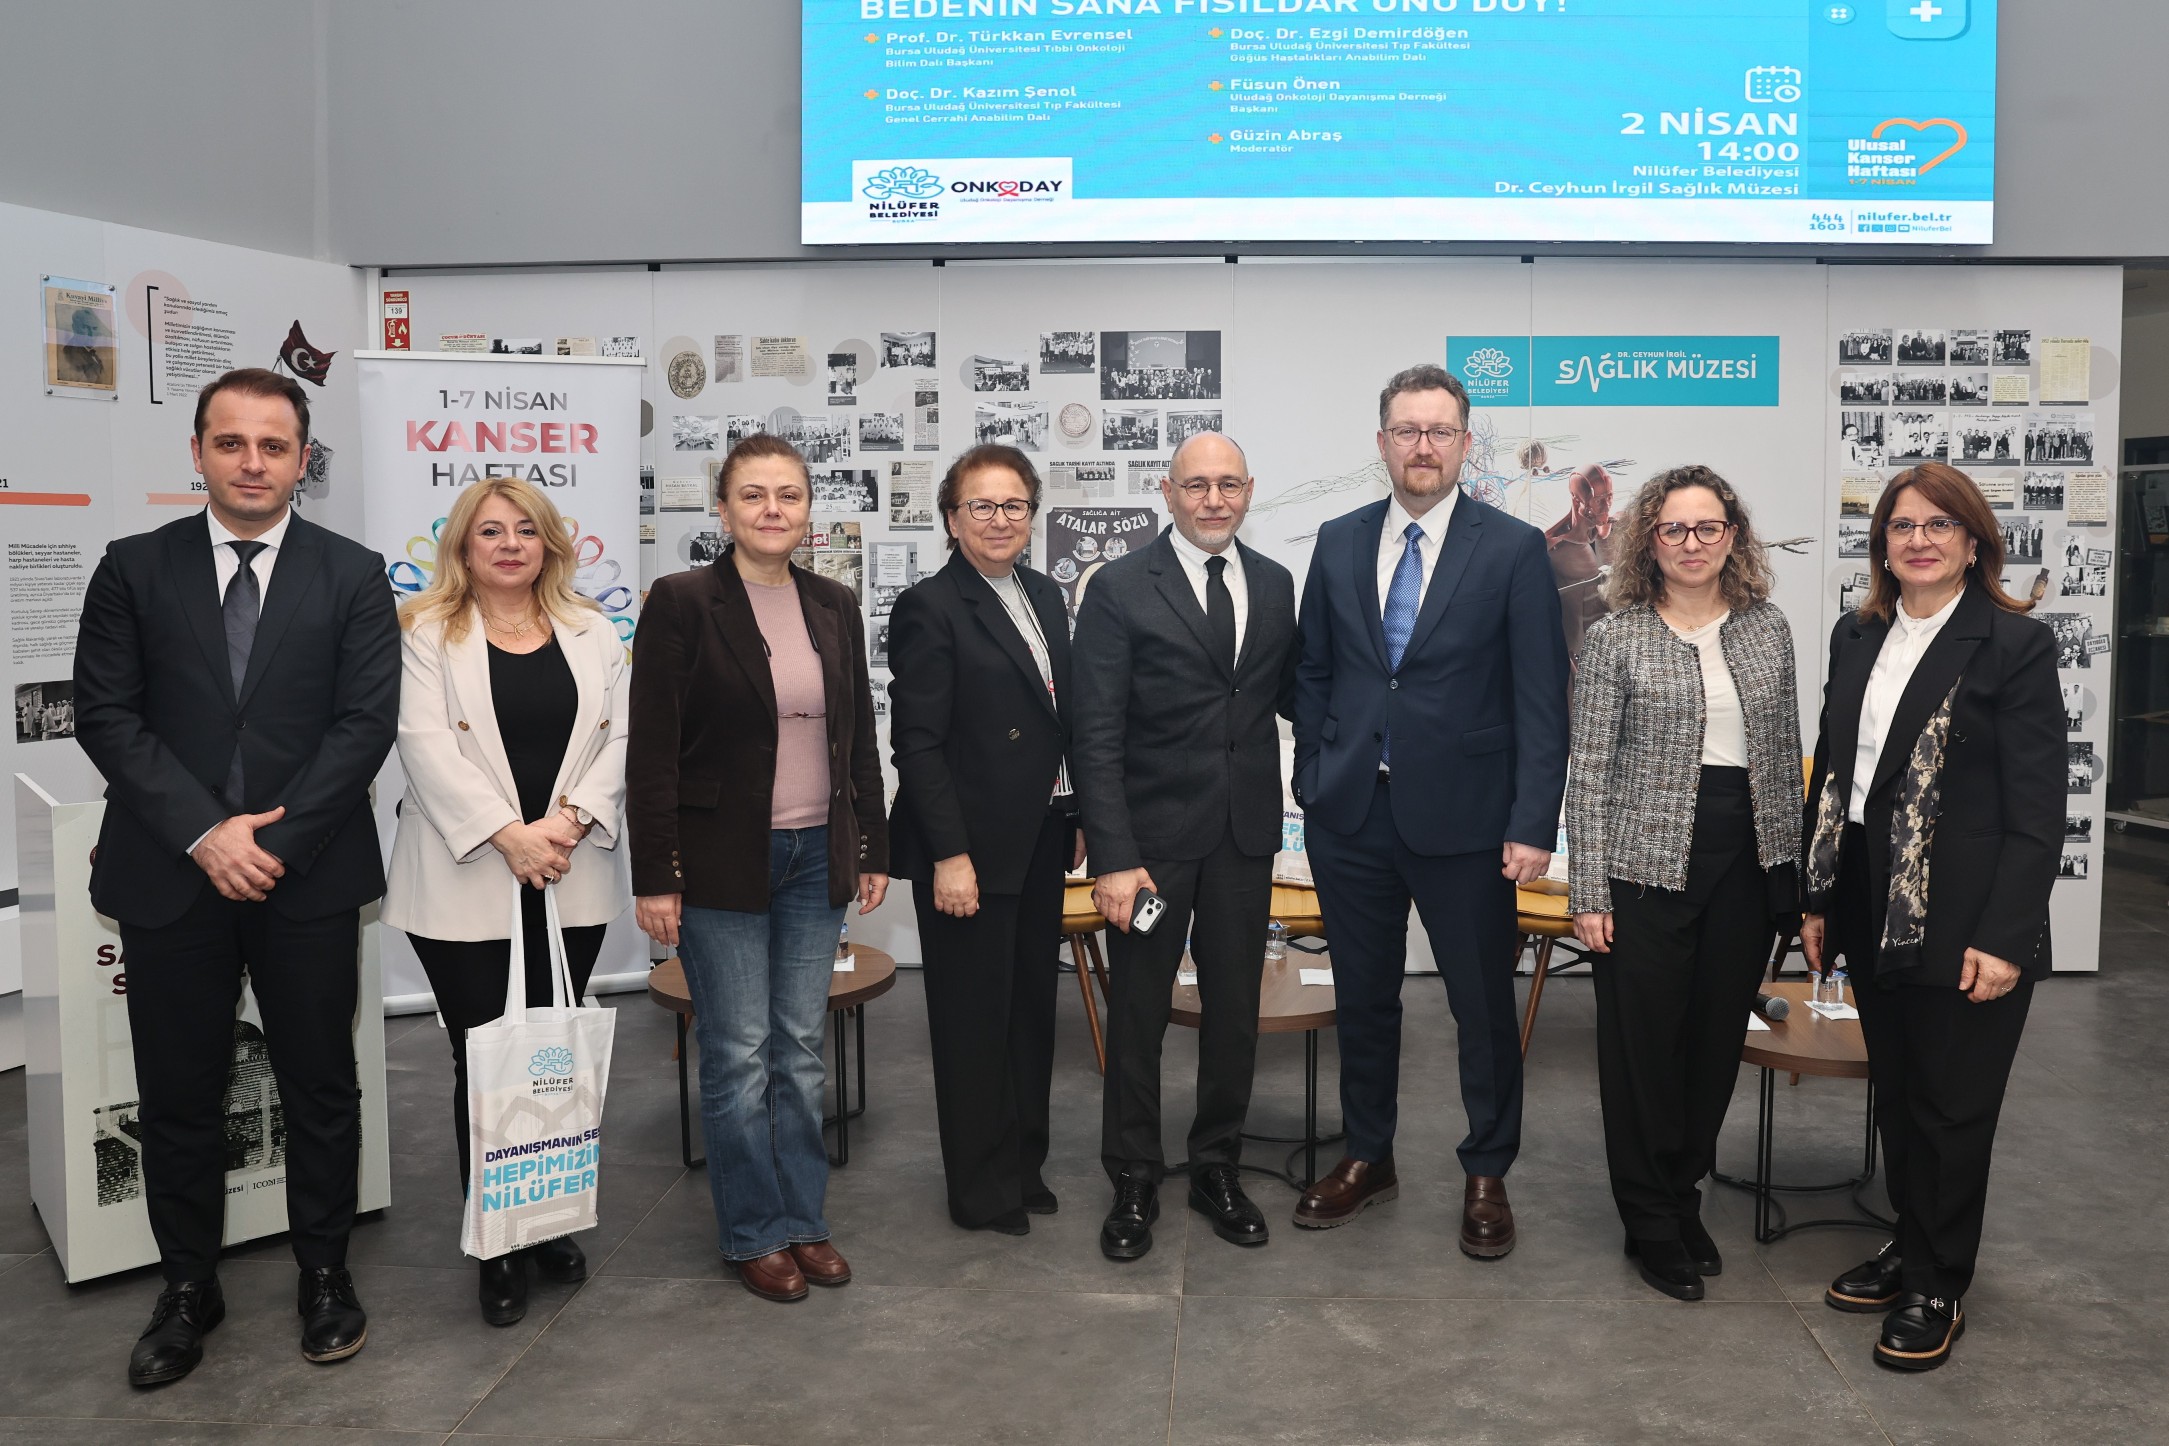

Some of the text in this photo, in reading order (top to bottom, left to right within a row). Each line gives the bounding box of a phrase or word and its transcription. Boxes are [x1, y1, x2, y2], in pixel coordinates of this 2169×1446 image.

[1051, 0, 1161, 15] SANA
[1174, 0, 1359, 14] FISILDAR
[1372, 0, 1455, 12] ONU
[887, 29, 1132, 44] Prof. Dr. Türkkan Evrensel
[1231, 27, 1468, 42] Doç. Dr. Ezgi Demirdöğen
[924, 47, 965, 56] Uludağ
[970, 44, 1040, 54] Üniversitesi
[1044, 44, 1073, 52] Tıbbi
[1076, 44, 1125, 53] Onkoloji
[1231, 41, 1470, 51] Bursa Uludağ Üniversitesi Tıp Fakültesi
[886, 59, 993, 68] Bilim Dalı Başkanı
[1230, 54, 1267, 63] Göğüs
[1346, 53, 1399, 61] Anabilim
[1403, 53, 1426, 61] Dalı
[1231, 76, 1340, 90] Füsun Önen
[887, 86, 1077, 101] Doç. Dr. Kazım Şenol
[1230, 92, 1447, 102] Uludağ Onkoloji Dayanışma Derneği
[886, 101, 1121, 112] Bursa Uludağ Üniversitesi Tıp Fakültesi
[1230, 105, 1278, 114] Başkanı
[886, 113, 1050, 123] Genel Cerrahi Anabilim Dalı
[1620, 107, 1798, 135] 2 NİSAN
[1230, 130, 1342, 142] Güzin Abraş
[1230, 145, 1294, 153] Moderatör
[1698, 141, 1799, 161] 14:00
[1848, 139, 1906, 151] Ulusal
[1848, 152, 1916, 164] Kanser
[1633, 165, 1799, 179] Nilüfer Belediyesi
[1848, 165, 1916, 177] Haftası
[1495, 180, 1799, 197] Dr. Ceyhun İrgil Sağlık Müzesi
[870, 201, 940, 210] NİLÜFER
[870, 210, 938, 218] BELEDİYESİ
[1858, 212, 1952, 221] nilufer.bel.tr
[1666, 350, 1687, 358] İRGİL
[1555, 353, 1756, 393] SAĞLIK MÜZESİ
[439, 386, 568, 411] 1-7 NİSAN
[406, 420, 599, 454] KANSER
[1147, 460, 1160, 468] KAYIT
[432, 462, 577, 488] HAFTASI
[190, 482, 208, 490] 192
[1056, 512, 1149, 534] ATALAR SÖZÜ
[533, 1078, 573, 1087] NİLÜFER
[485, 1133, 582, 1163] DAYANIŞMANIN
[482, 1169, 596, 1213] NİLÜFER
